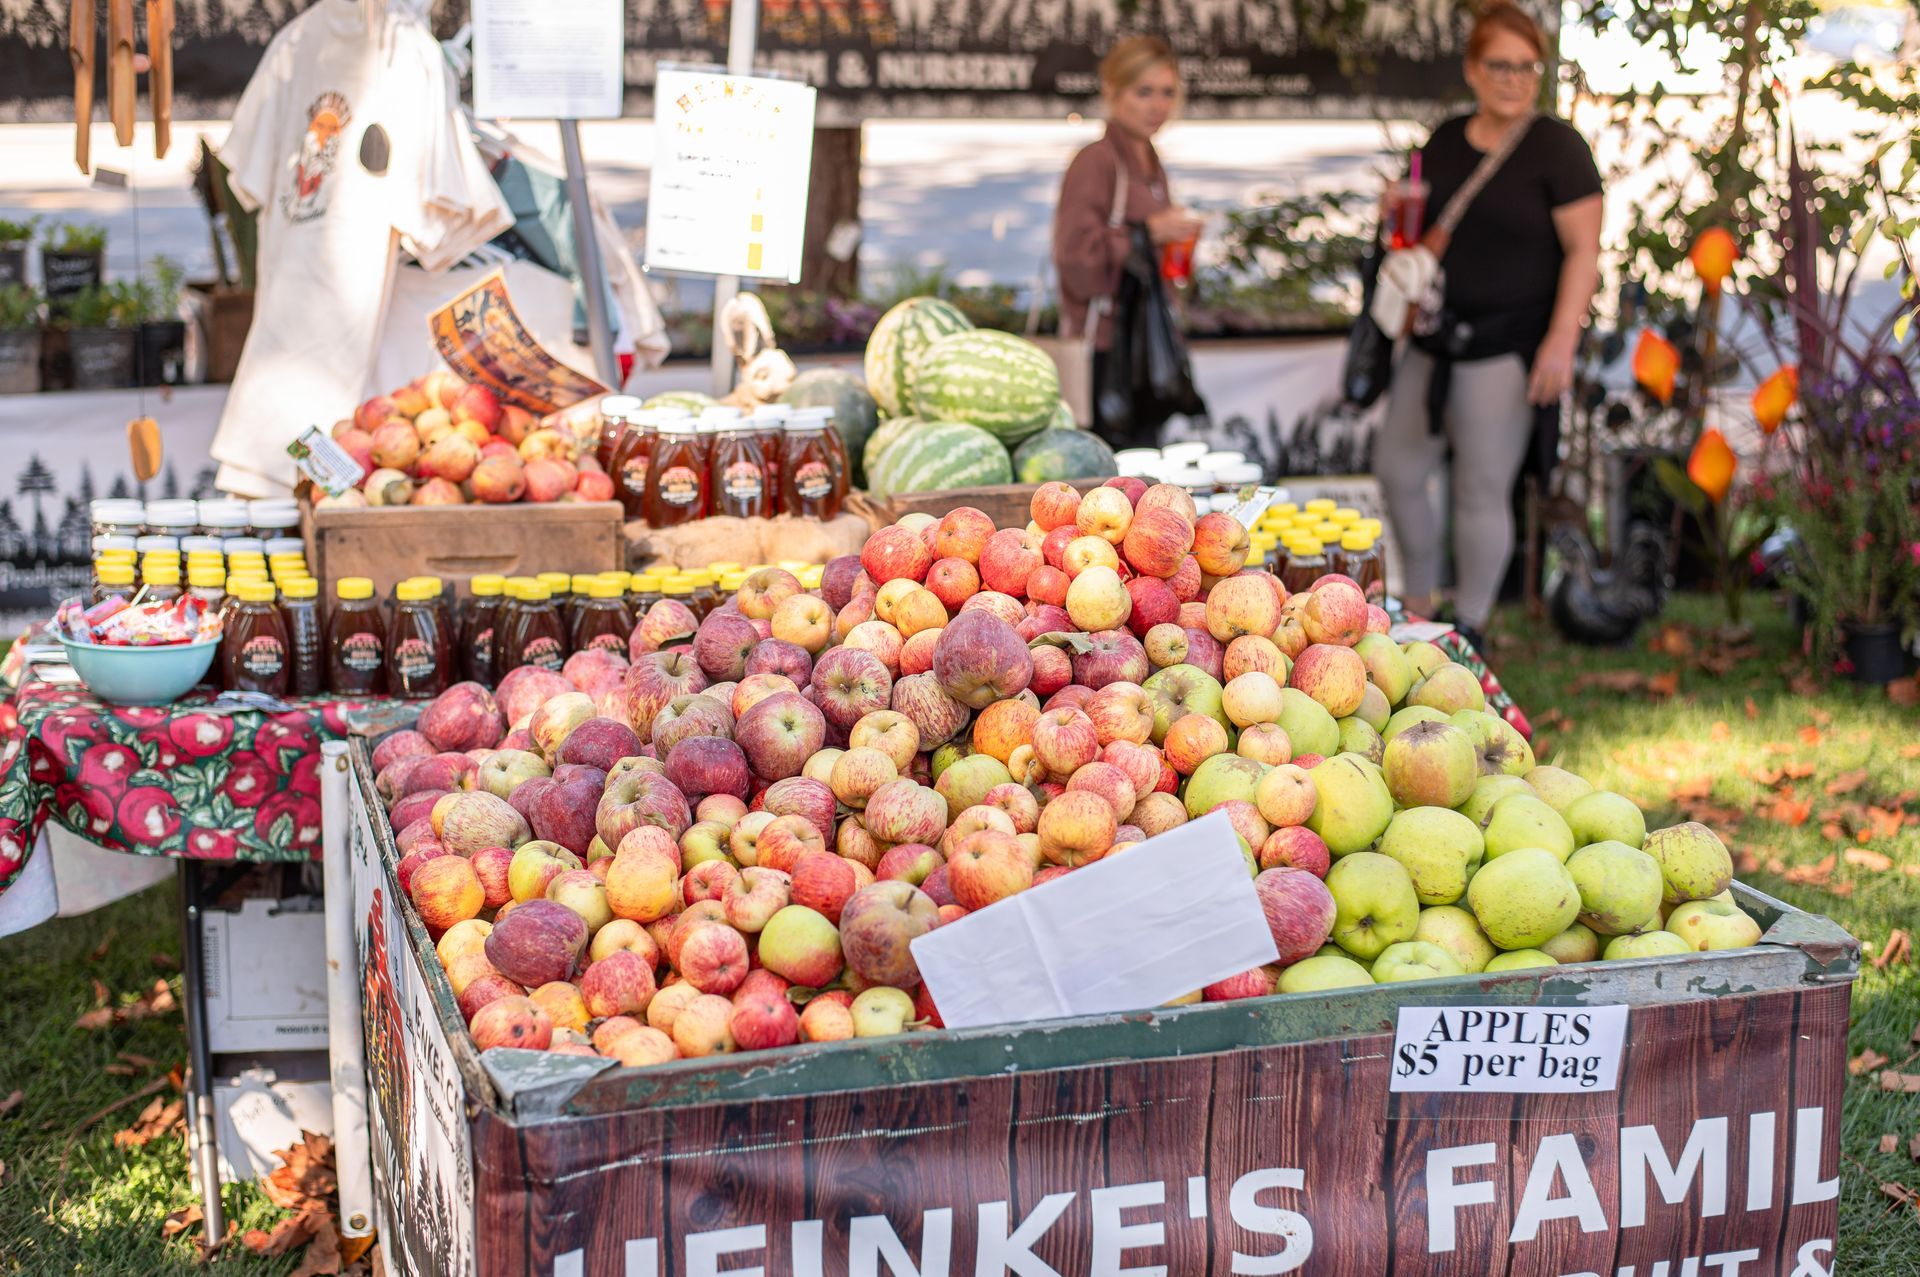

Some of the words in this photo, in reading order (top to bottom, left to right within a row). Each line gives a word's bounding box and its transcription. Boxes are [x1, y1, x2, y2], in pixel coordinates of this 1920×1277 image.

[1424, 1010, 1592, 1046] APPLES
[1396, 1043, 1440, 1078] $5
[1459, 1053, 1526, 1085] per
[1537, 1046, 1602, 1088] bag
[554, 1168, 1314, 1277] INKE'S
[1426, 1107, 1840, 1255] FAMIL
